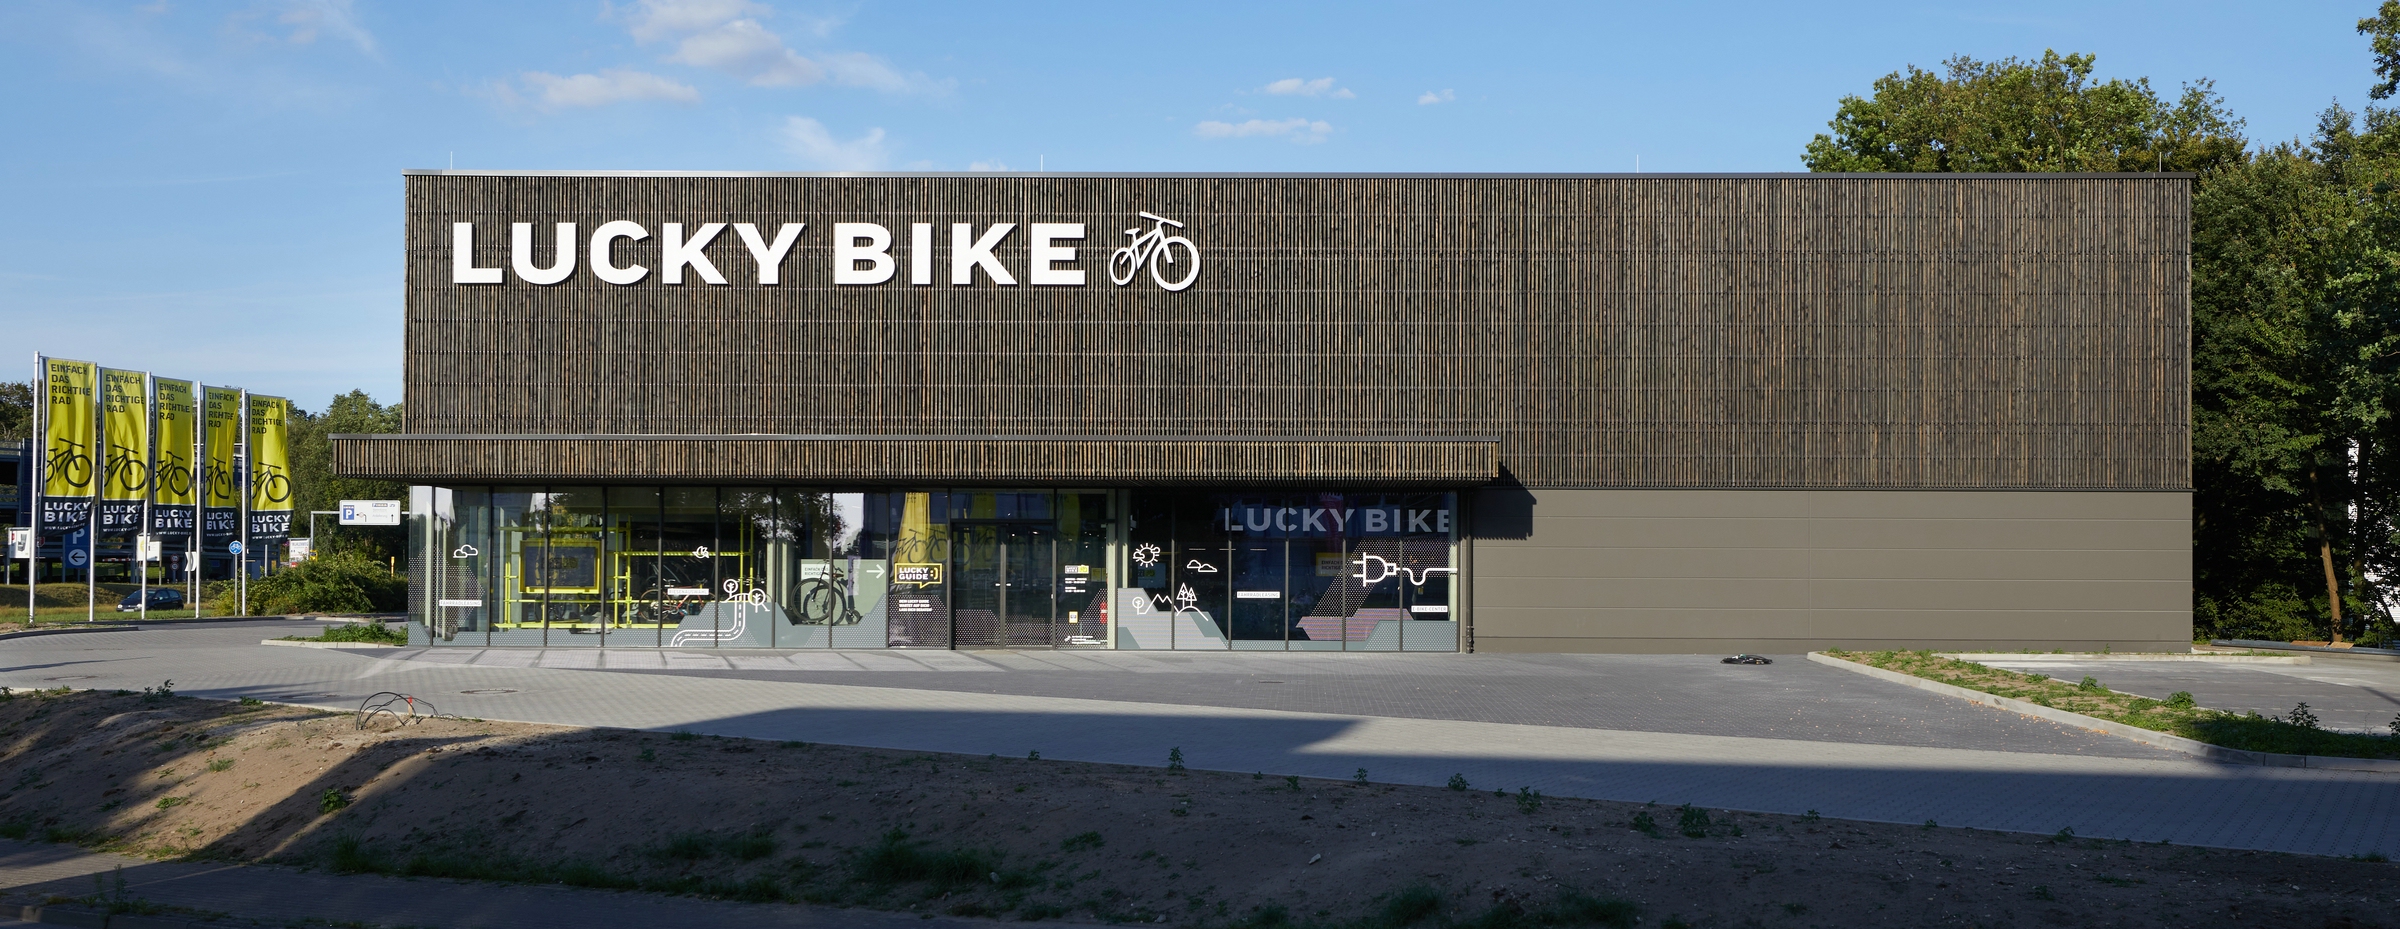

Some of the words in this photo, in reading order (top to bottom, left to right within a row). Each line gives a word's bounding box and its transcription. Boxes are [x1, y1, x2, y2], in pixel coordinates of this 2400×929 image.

[453, 220, 805, 286] LUCKY
[835, 223, 1085, 286] BIKE
[51, 364, 88, 376] EINFACH
[51, 374, 70, 384] DAS
[106, 374, 141, 384] EINFACH
[106, 384, 122, 392] DAS
[159, 383, 186, 394] EINFACH
[52, 396, 72, 405] RAD
[106, 394, 144, 404] RICHTIGE
[160, 392, 174, 402] DAS
[208, 402, 222, 410] DAS
[252, 400, 280, 409] EINFACH
[160, 412, 174, 420] RAD
[44, 502, 92, 510] LUCKY
[103, 504, 142, 514] LUCKY
[44, 511, 88, 523] BIKE
[155, 509, 192, 518] LUCKY
[206, 512, 234, 520] LUCKY
[252, 514, 291, 522] LUCKY
[346, 509, 352, 519] P
[103, 514, 139, 524] BIKE
[155, 518, 192, 528] BIKE
[1224, 508, 1354, 532] LUCKY
[1366, 509, 1449, 532] BIKE
[206, 520, 235, 530] BIKE
[252, 523, 290, 532] BIKE
[72, 528, 85, 544] P
